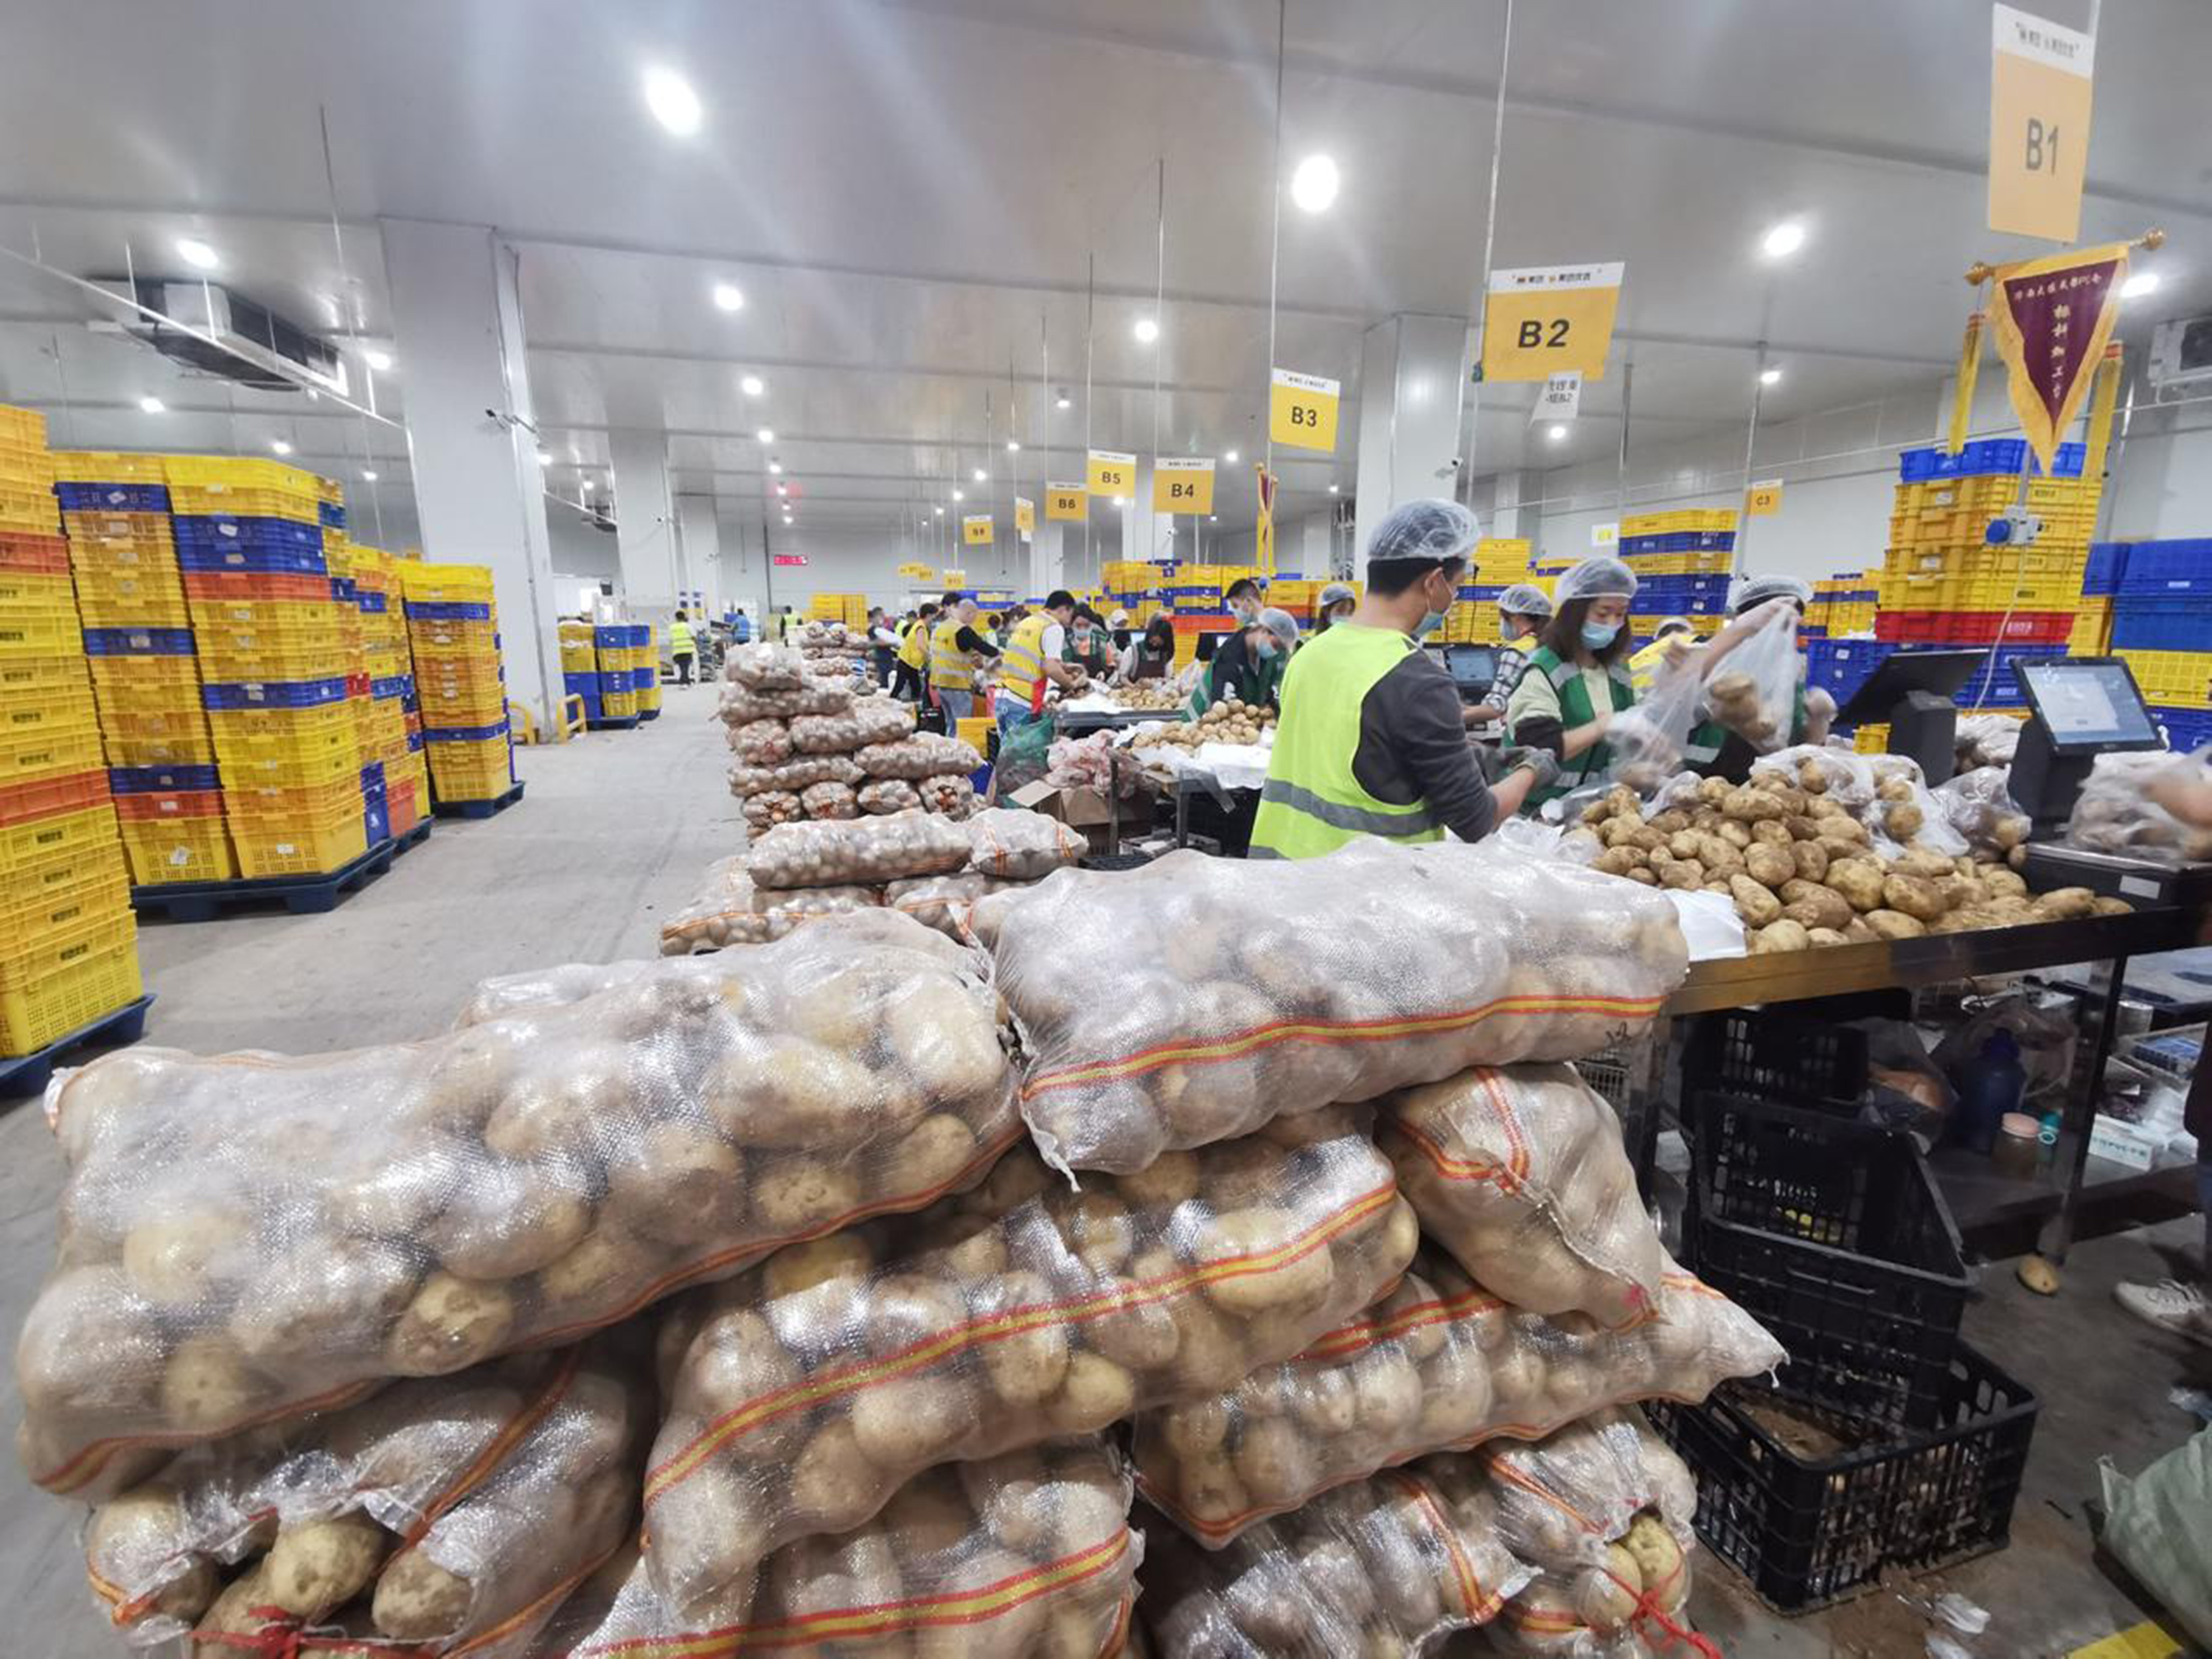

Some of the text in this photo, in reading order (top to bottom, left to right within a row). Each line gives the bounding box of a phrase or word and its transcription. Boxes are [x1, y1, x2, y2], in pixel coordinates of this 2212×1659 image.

[2025, 117, 2059, 175] B1
[1517, 318, 1571, 348] B2
[1291, 406, 1317, 427] B3
[1101, 471, 1121, 484] B5
[1171, 483, 1194, 498] B4
[1058, 498, 1076, 509] B6
